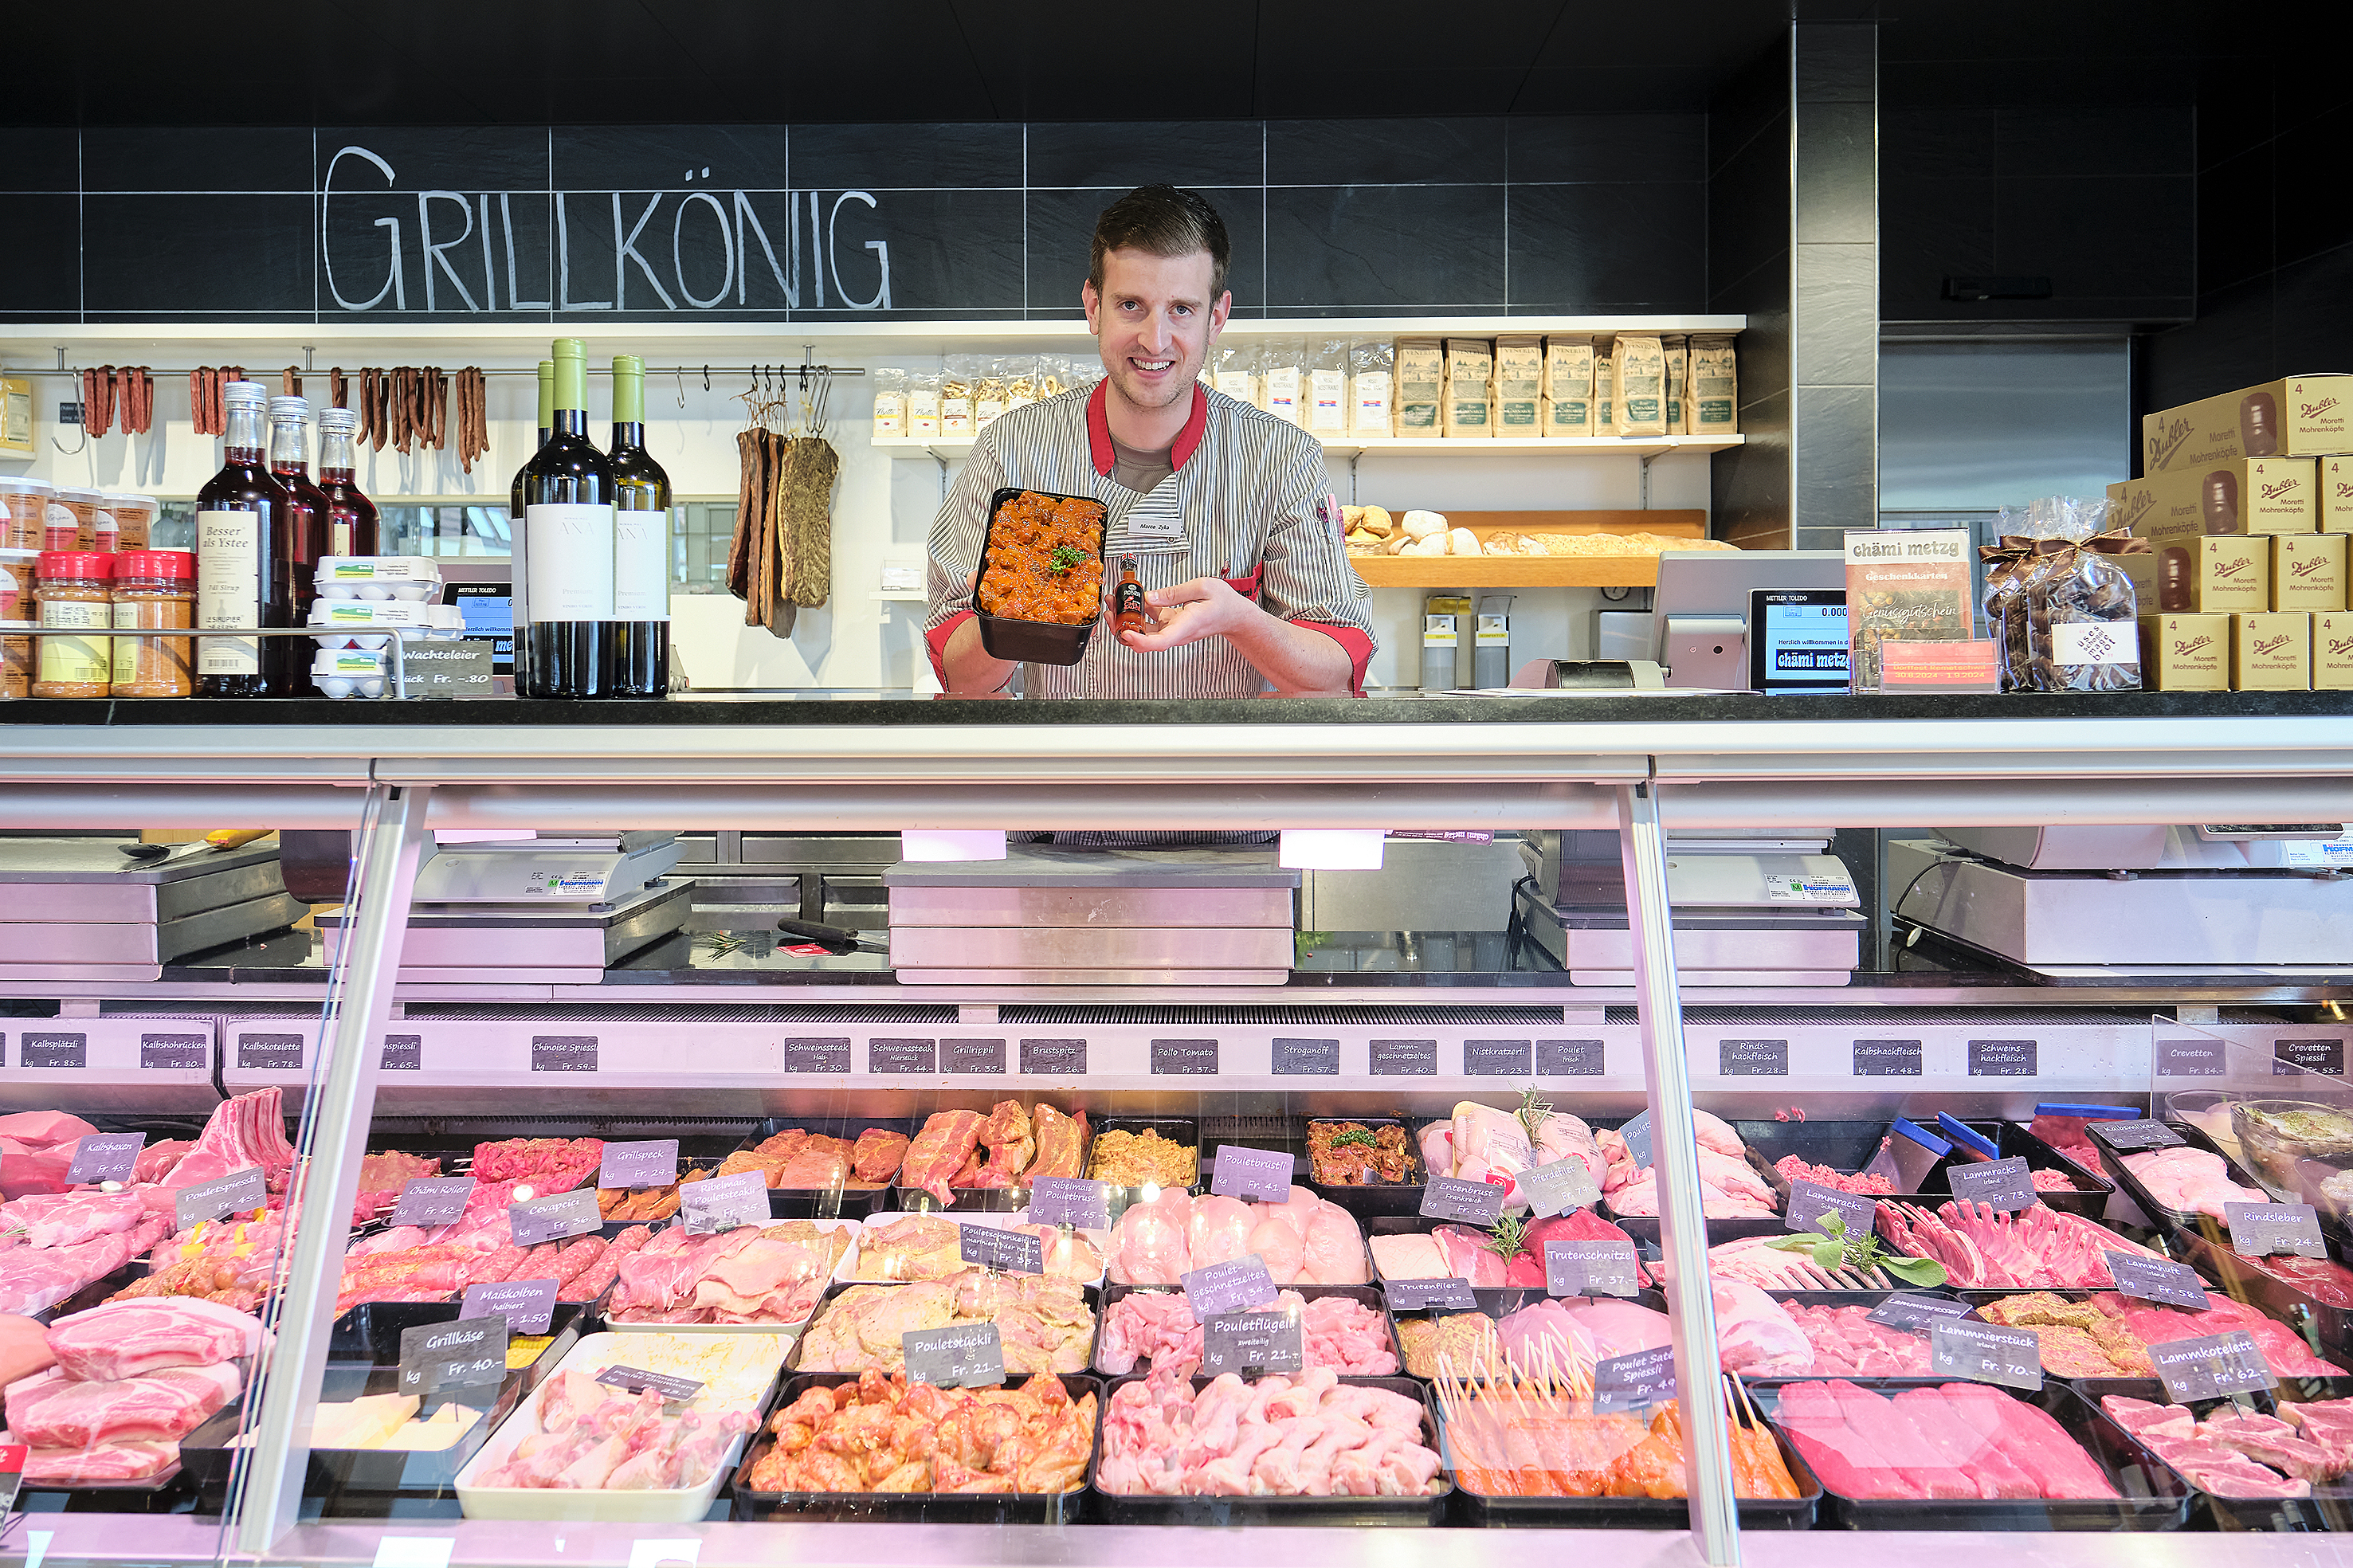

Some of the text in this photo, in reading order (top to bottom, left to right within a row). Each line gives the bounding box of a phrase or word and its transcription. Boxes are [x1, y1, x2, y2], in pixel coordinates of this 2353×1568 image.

[322, 146, 891, 315] GRILLKÖNIG
[2295, 384, 2303, 394] 4
[2300, 397, 2340, 418] Dubler
[2210, 429, 2235, 443] Moretti
[2190, 446, 2237, 465] Mohrenköpfe
[2257, 464, 2264, 474] 4
[2262, 478, 2300, 499] Dubler
[206, 526, 241, 536] Besser
[202, 537, 248, 547] als Ystee
[1853, 540, 1959, 557] chämi metzg
[2210, 543, 2217, 553] 4
[2215, 556, 2254, 578] Dubler
[1866, 572, 1947, 581] Geschenkkarten
[1822, 607, 1848, 617] 0.000
[1863, 604, 1957, 625] Genussgutschein
[2170, 621, 2177, 631] 4
[2175, 636, 2214, 656] Dubler
[403, 650, 479, 660] Wachteleier
[1778, 653, 1814, 668] chämi
[391, 675, 424, 684] Sück
[31, 1039, 78, 1049] Kalbsplätzli
[143, 1041, 206, 1049] Kalbshohrücken
[242, 1042, 300, 1051] Kalbskotelette
[570, 1043, 598, 1053] Spiessli
[789, 1044, 848, 1053] Schweinssteak
[873, 1044, 933, 1053] Schweinssteak
[1981, 1044, 2026, 1053] Schweins-
[953, 1046, 994, 1056] Grillrippli
[1033, 1046, 1076, 1056] Brustspitz
[1158, 1048, 1214, 1056] Pollo Tomato
[1284, 1045, 1329, 1055] Stroganoff
[1472, 1047, 1525, 1056] Nistkratzerli
[1558, 1045, 1584, 1054] Poulet
[1855, 1047, 1922, 1056] Kalbshackfleisch
[2171, 1049, 2213, 1057] Crevetten
[1731, 1052, 1778, 1060] hackfleisch
[2295, 1053, 2325, 1063] Spiessli
[1024, 1065, 1033, 1075] kg
[87, 1143, 132, 1152] Kalbshaxen
[618, 1149, 664, 1161] Grillspeck
[1224, 1154, 1288, 1171] Pouletbrüstli
[73, 1166, 82, 1175] kg
[605, 1171, 614, 1180] kg
[1531, 1164, 1575, 1185] Pferdefilet
[1963, 1165, 2017, 1181] Lammracks
[185, 1174, 257, 1202] Pouletspiessli
[409, 1185, 468, 1195] Chämi Roller
[700, 1177, 747, 1194] Ribelmais
[1051, 1180, 1093, 1191] Ribelmais
[1438, 1183, 1494, 1197] Entenbrust
[695, 1186, 755, 1205] Pouletsteakli
[1045, 1190, 1096, 1203] Pouletbrust
[1445, 1194, 1482, 1204] Frankreich
[1806, 1189, 1862, 1211] Lammracks
[528, 1198, 580, 1215] Cevapcici
[2244, 1212, 2304, 1223] Rindsleber
[963, 1226, 1041, 1246] Pouletschenkelfilet
[2239, 1236, 2251, 1245] kg
[2274, 1237, 2290, 1246] Fr.
[1547, 1250, 1634, 1260] Trutenschnitzel
[2125, 1259, 2181, 1275] Lammhuft
[1204, 1264, 1244, 1281] Poulet-
[1192, 1268, 1266, 1299] geschnetzeltes
[1554, 1276, 1566, 1286] kg
[1589, 1276, 1604, 1284] Fr.
[479, 1287, 543, 1301] Maiskolben
[492, 1301, 524, 1311] halbiert
[1887, 1298, 1961, 1315] Lammvoressen
[1214, 1319, 1296, 1335] Pouletflügeli
[426, 1330, 484, 1350] Grillkäse
[1939, 1324, 2034, 1348] Lammnierstück
[914, 1333, 992, 1353] Pouletstückli
[1237, 1338, 1269, 1347] zweiteilig
[2159, 1340, 2253, 1365] Lammkotelett
[1613, 1350, 1674, 1372] Poulet Saté
[1623, 1365, 1662, 1383] Spiessli
